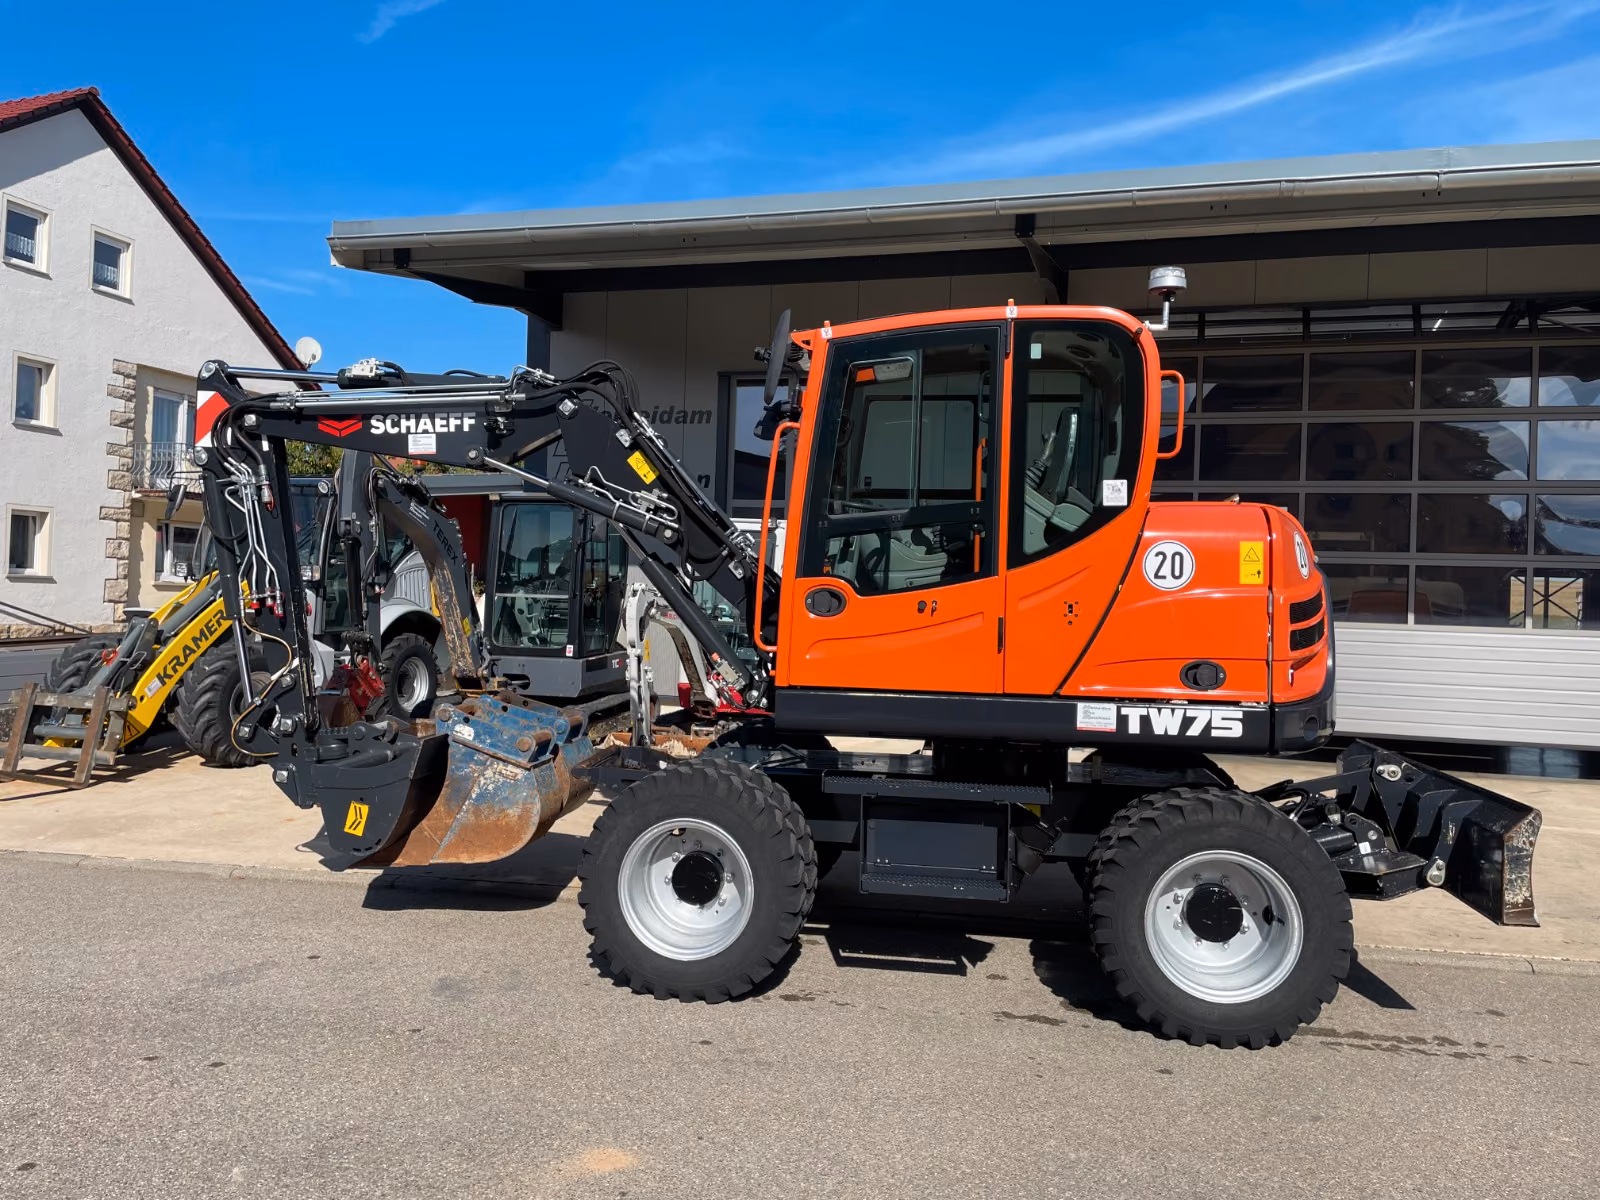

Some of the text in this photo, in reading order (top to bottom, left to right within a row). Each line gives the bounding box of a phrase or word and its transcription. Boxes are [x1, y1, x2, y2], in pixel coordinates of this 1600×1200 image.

[369, 412, 477, 435] SCHAEFF
[432, 520, 459, 567] TEREX
[1153, 550, 1184, 580] 20
[156, 609, 229, 687] KRAMER
[1120, 707, 1244, 738] TW75
